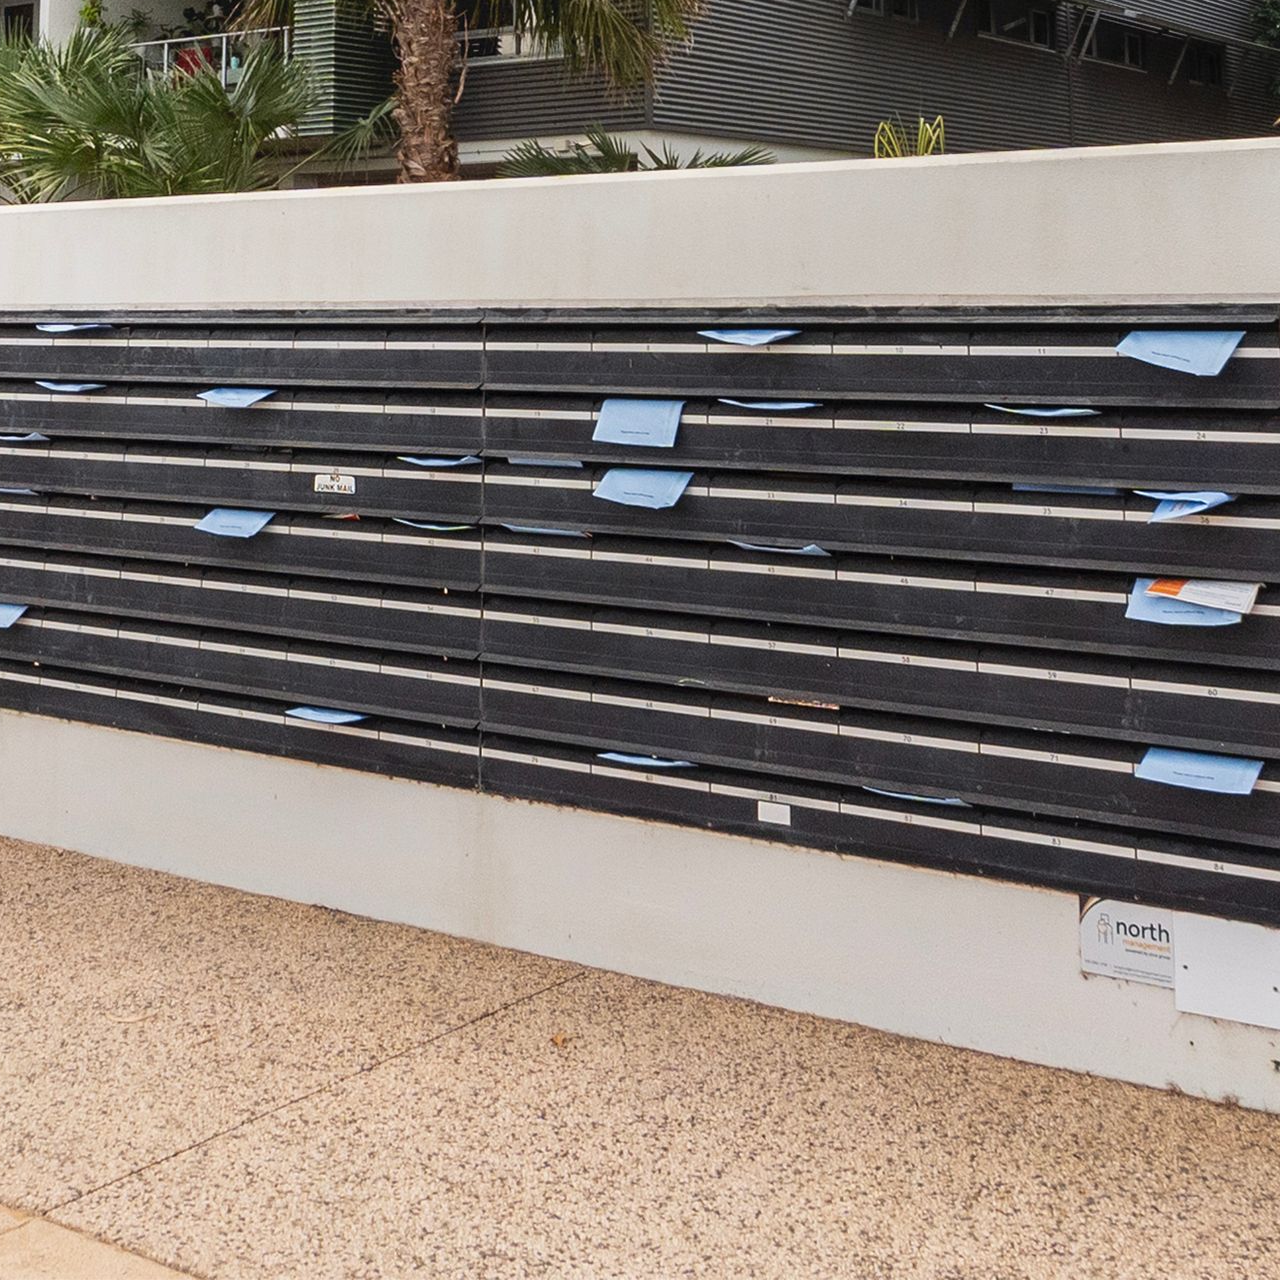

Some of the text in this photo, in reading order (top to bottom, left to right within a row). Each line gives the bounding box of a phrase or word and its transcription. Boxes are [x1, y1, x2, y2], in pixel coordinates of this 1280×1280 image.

[895, 346, 904, 354] 10
[896, 422, 905, 430] 22
[1039, 427, 1049, 435] 23
[1196, 431, 1206, 440] 24
[330, 474, 340, 483] NO
[317, 483, 353, 493] JUNK MAIL
[1044, 587, 1055, 596] 47
[1207, 688, 1218, 697] 60
[903, 734, 912, 744] 70
[1116, 920, 1170, 943] north
